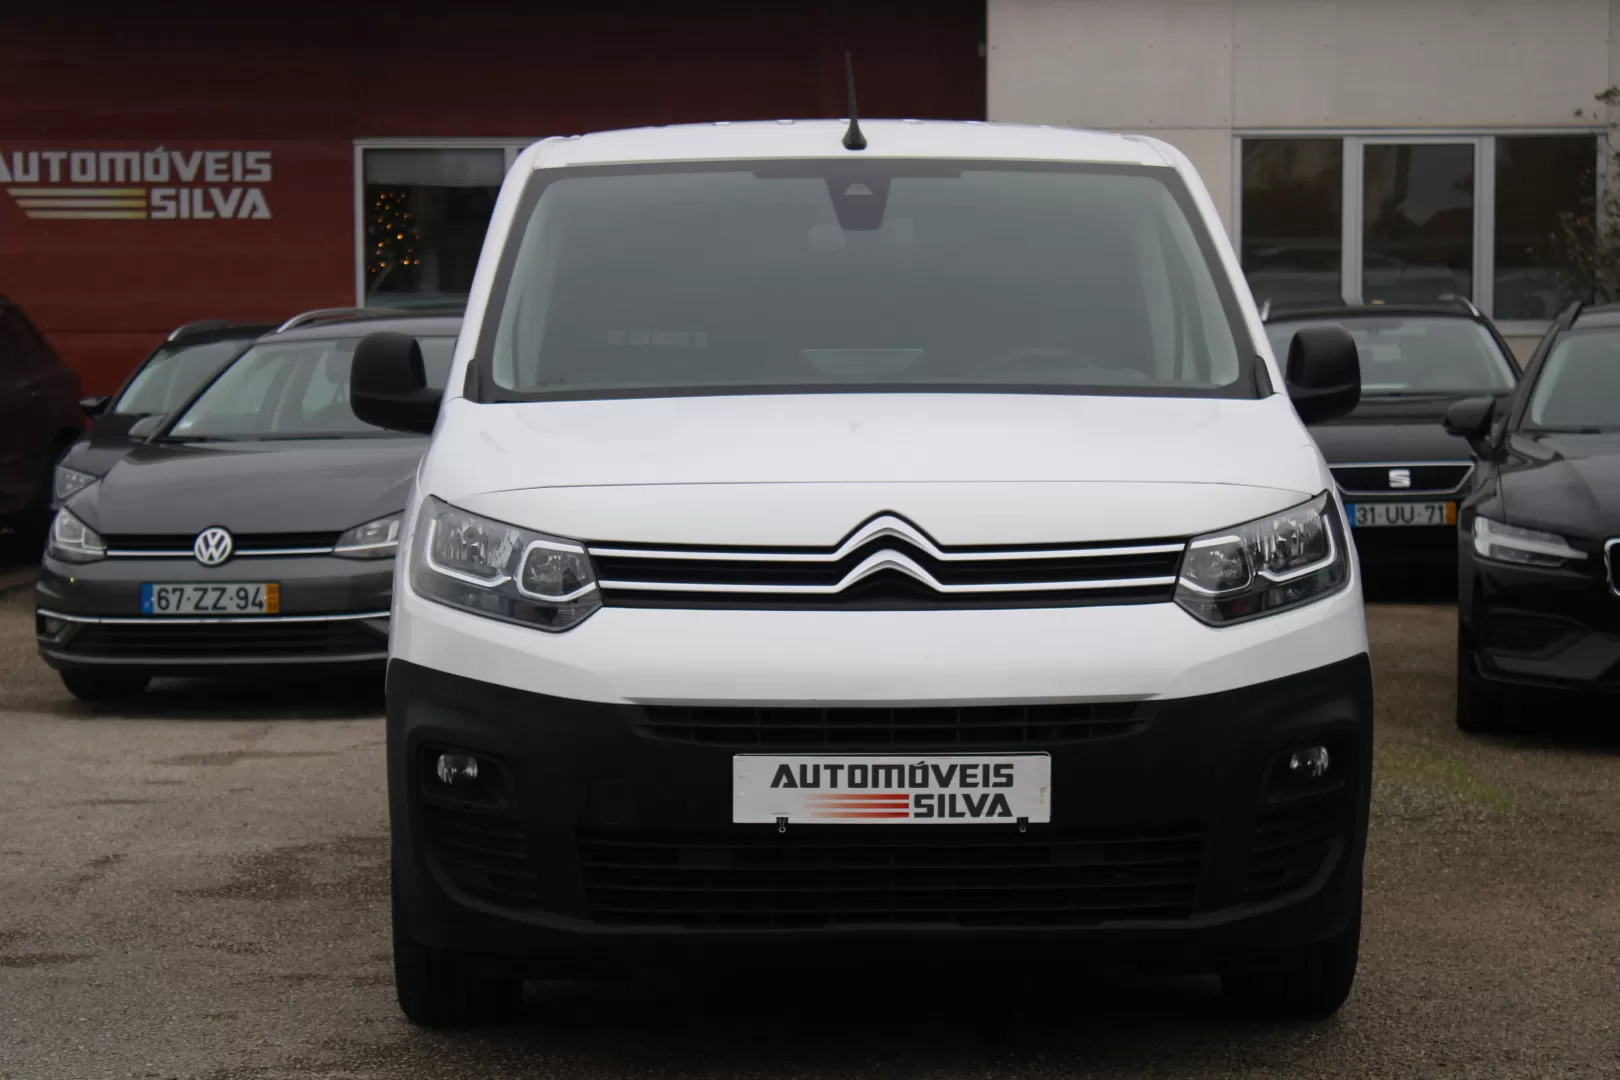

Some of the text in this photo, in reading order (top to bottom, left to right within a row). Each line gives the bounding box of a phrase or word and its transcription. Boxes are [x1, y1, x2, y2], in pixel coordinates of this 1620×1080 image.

[150, 188, 272, 219] SILVA
[769, 760, 1015, 789] AUTOMÓVEIS
[913, 793, 1013, 818] SILVA
